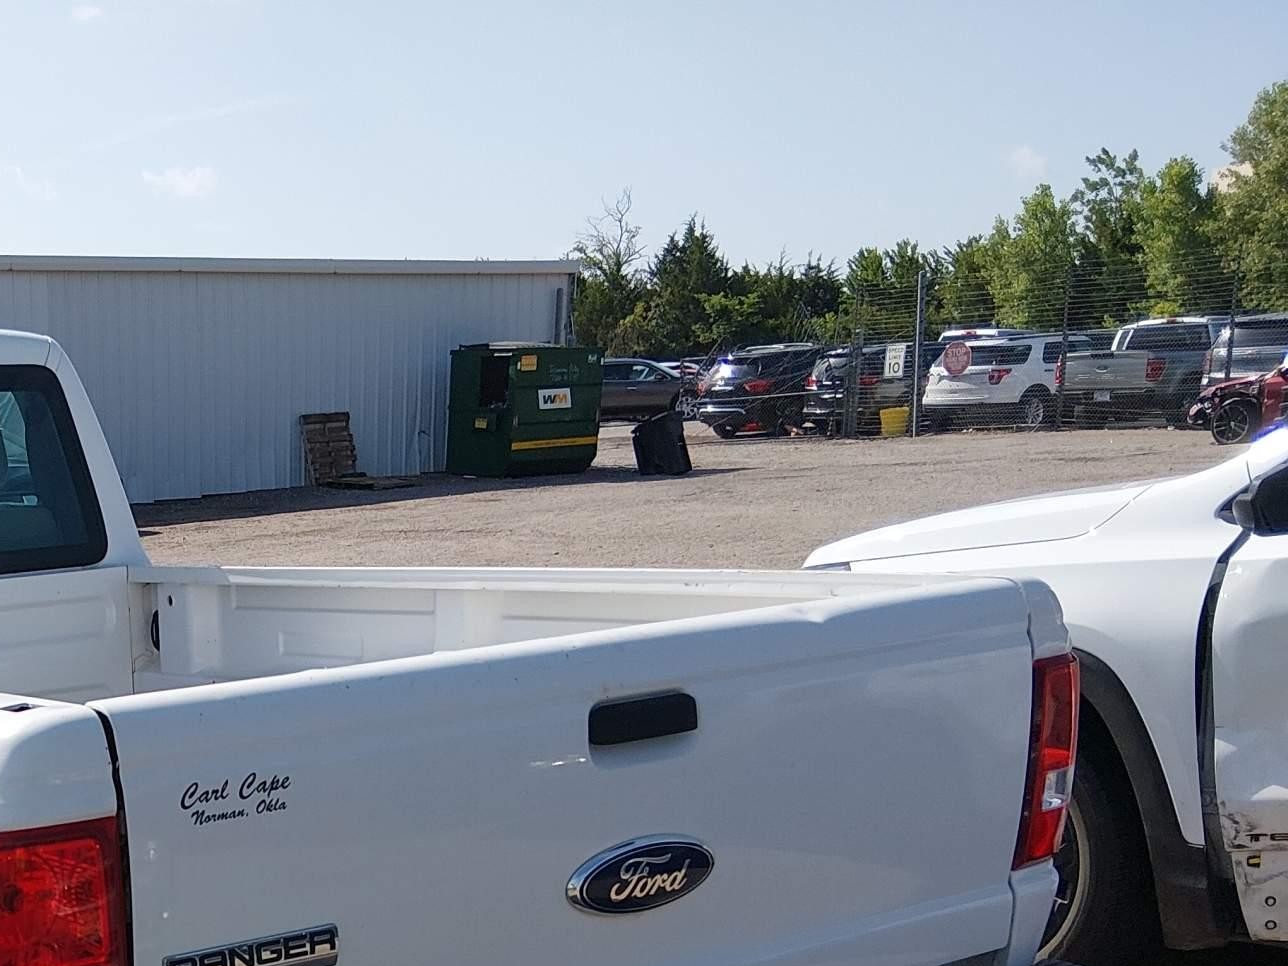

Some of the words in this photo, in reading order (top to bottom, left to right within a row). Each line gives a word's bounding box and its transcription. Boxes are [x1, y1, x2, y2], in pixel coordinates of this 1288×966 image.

[888, 362, 901, 374] 10
[542, 393, 568, 405] WM
[180, 780, 230, 810] Carl
[238, 772, 292, 800] Cape
[191, 807, 249, 826] Norman,
[255, 799, 288, 814] Okla
[610, 853, 691, 902] Ford
